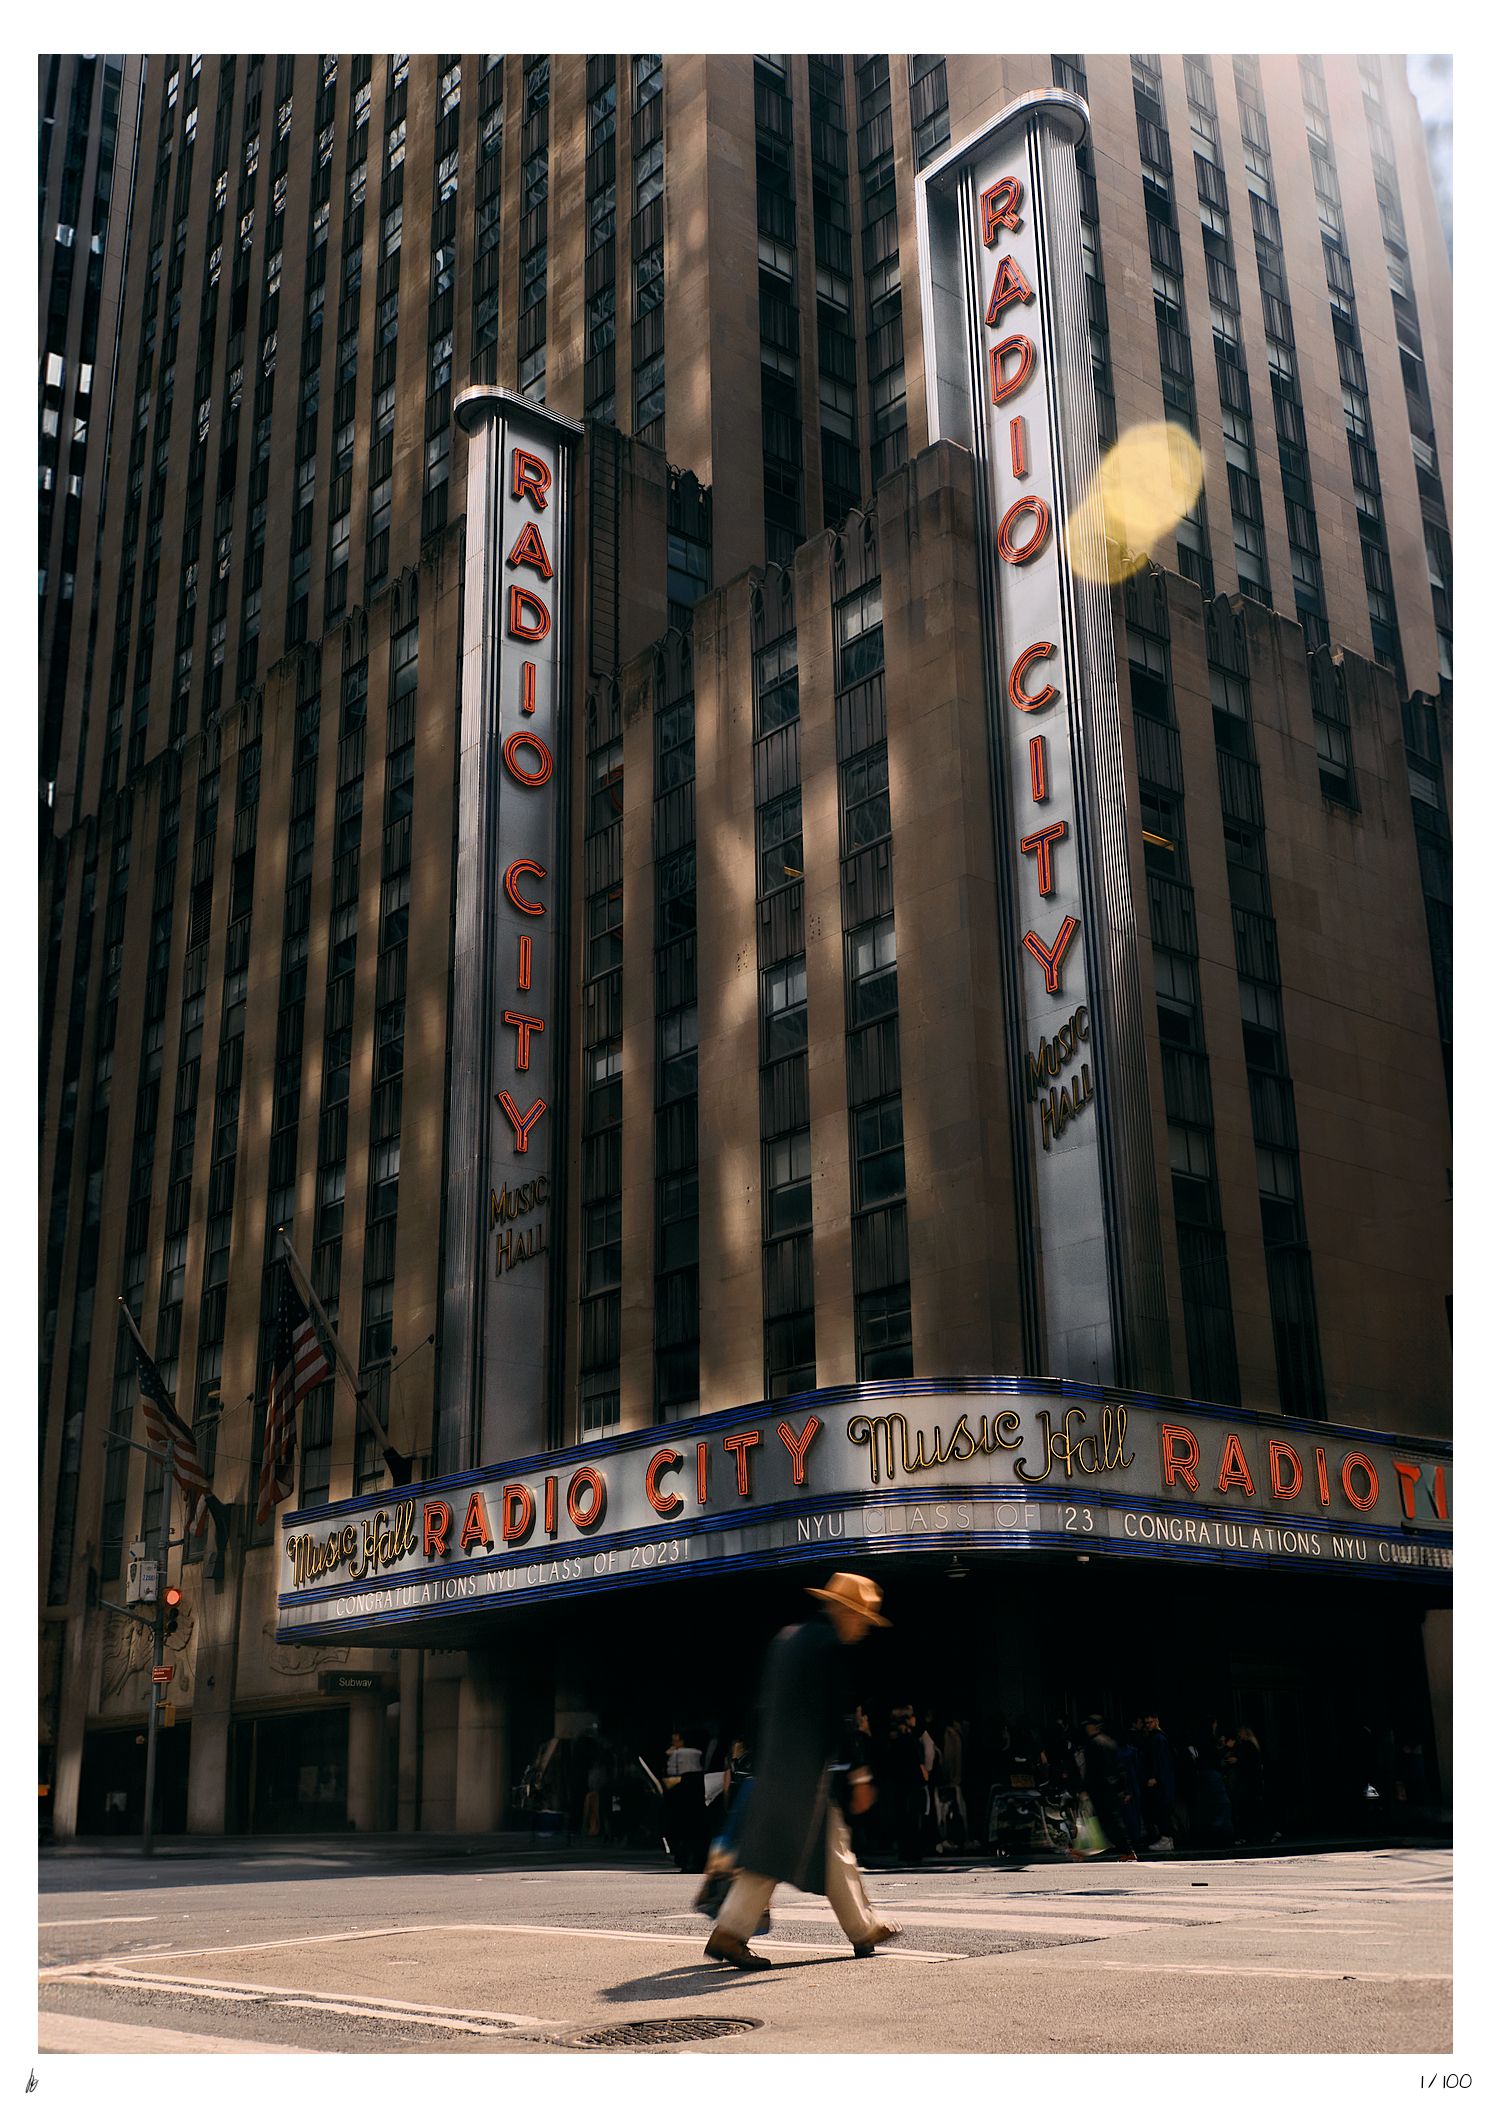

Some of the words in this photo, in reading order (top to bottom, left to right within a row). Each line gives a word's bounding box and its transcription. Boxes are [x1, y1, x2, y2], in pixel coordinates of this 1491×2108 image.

[980, 174, 1053, 567] RADIO
[503, 446, 554, 787] RADIO
[1007, 641, 1082, 996] CITY
[498, 857, 548, 1154] CITY
[1040, 1063, 1095, 1151] HALL
[495, 1223, 548, 1277] HALL
[423, 1466, 607, 1558] RADIO
[645, 1414, 824, 1517] CITY
[847, 1410, 1024, 1484] Music
[1014, 1404, 1135, 1483] Hall
[1159, 1422, 1380, 1513] RADIO
[797, 1513, 843, 1542] NYU
[865, 1503, 971, 1534] CLASS
[996, 1503, 1038, 1528] OF
[286, 1524, 355, 1587] Music
[349, 1498, 416, 1578] Hall
[336, 1574, 476, 1617] CONGRATULATIONS
[486, 1568, 517, 1592] NYU
[527, 1557, 582, 1585] CLASS
[593, 1550, 618, 1574] OF
[630, 1538, 690, 1569] 2023!
[1124, 1512, 1322, 1556] CONGRATULATIONS
[1332, 1536, 1368, 1561] NYU
[338, 1677, 373, 1688] Subway
